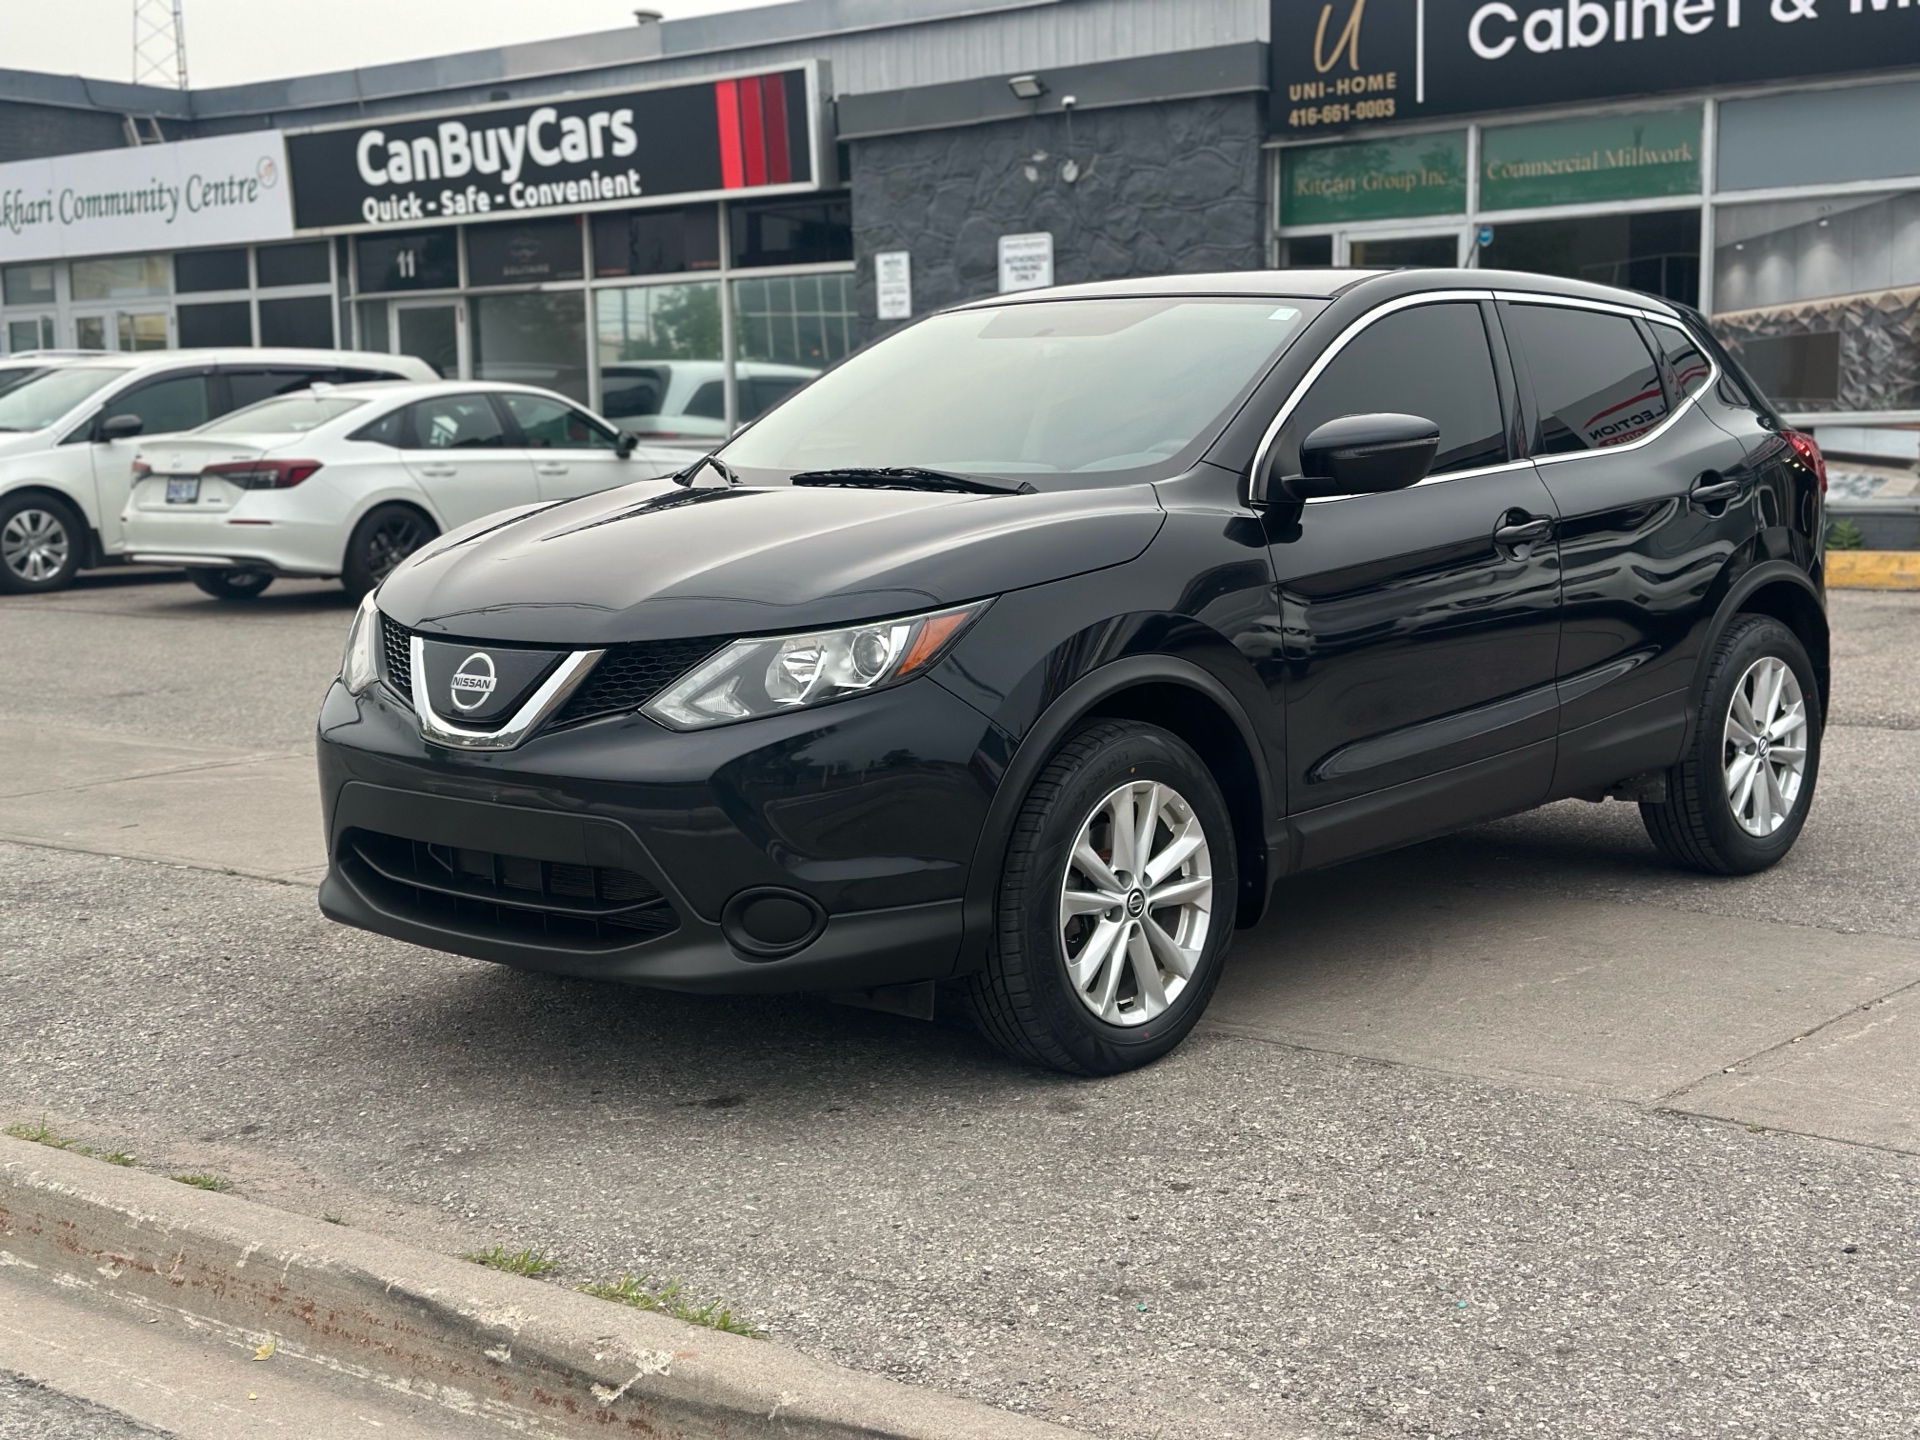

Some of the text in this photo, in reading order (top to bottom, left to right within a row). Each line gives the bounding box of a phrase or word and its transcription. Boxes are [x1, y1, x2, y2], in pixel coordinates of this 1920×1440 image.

[1288, 71, 1397, 101] UNI-HOME
[1288, 97, 1396, 127] 416-661-0003
[356, 107, 638, 186] CanBuyCars
[1486, 142, 1693, 180] Commercial Millwork
[1362, 169, 1417, 193] Group
[0, 173, 258, 235] khari Community Centre
[362, 192, 423, 225] Quick
[440, 185, 491, 216] Safe
[509, 168, 642, 208] Convenient
[395, 250, 415, 278] 11
[452, 676, 491, 690] NISSAN
